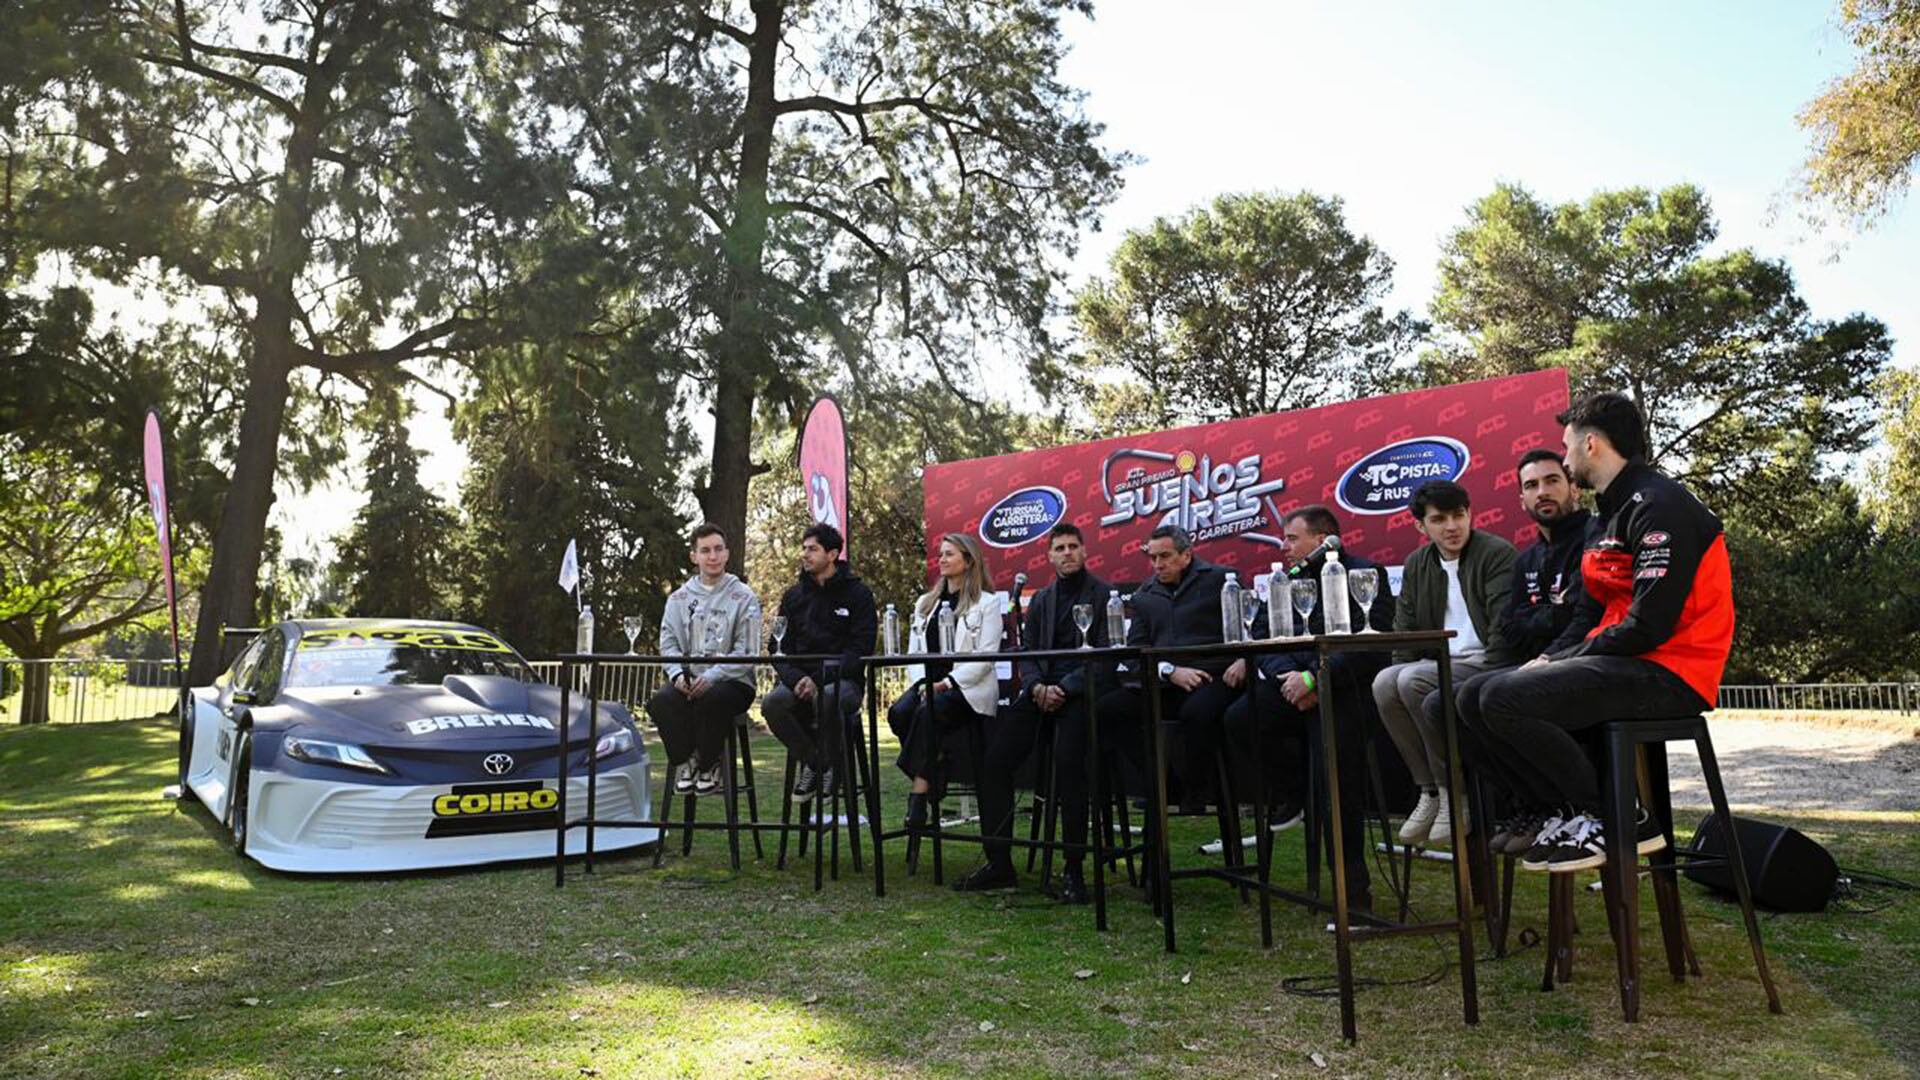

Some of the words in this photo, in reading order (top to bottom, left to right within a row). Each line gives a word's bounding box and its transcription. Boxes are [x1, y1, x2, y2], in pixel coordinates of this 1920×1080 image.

[1114, 478, 1140, 493] GRAN
[1141, 469, 1176, 485] PREMIO
[1367, 462, 1399, 486] TC
[1400, 463, 1440, 479] PISTA
[1101, 454, 1261, 526] BUENOS
[1384, 486, 1411, 500] RUS
[993, 513, 1049, 528] CARRETERA
[1003, 503, 1045, 517] TURISMO
[1010, 527, 1029, 537] RUS
[1199, 517, 1261, 542] CARRETERA
[406, 713, 555, 736] BREMEN
[434, 788, 558, 815] COIRO
